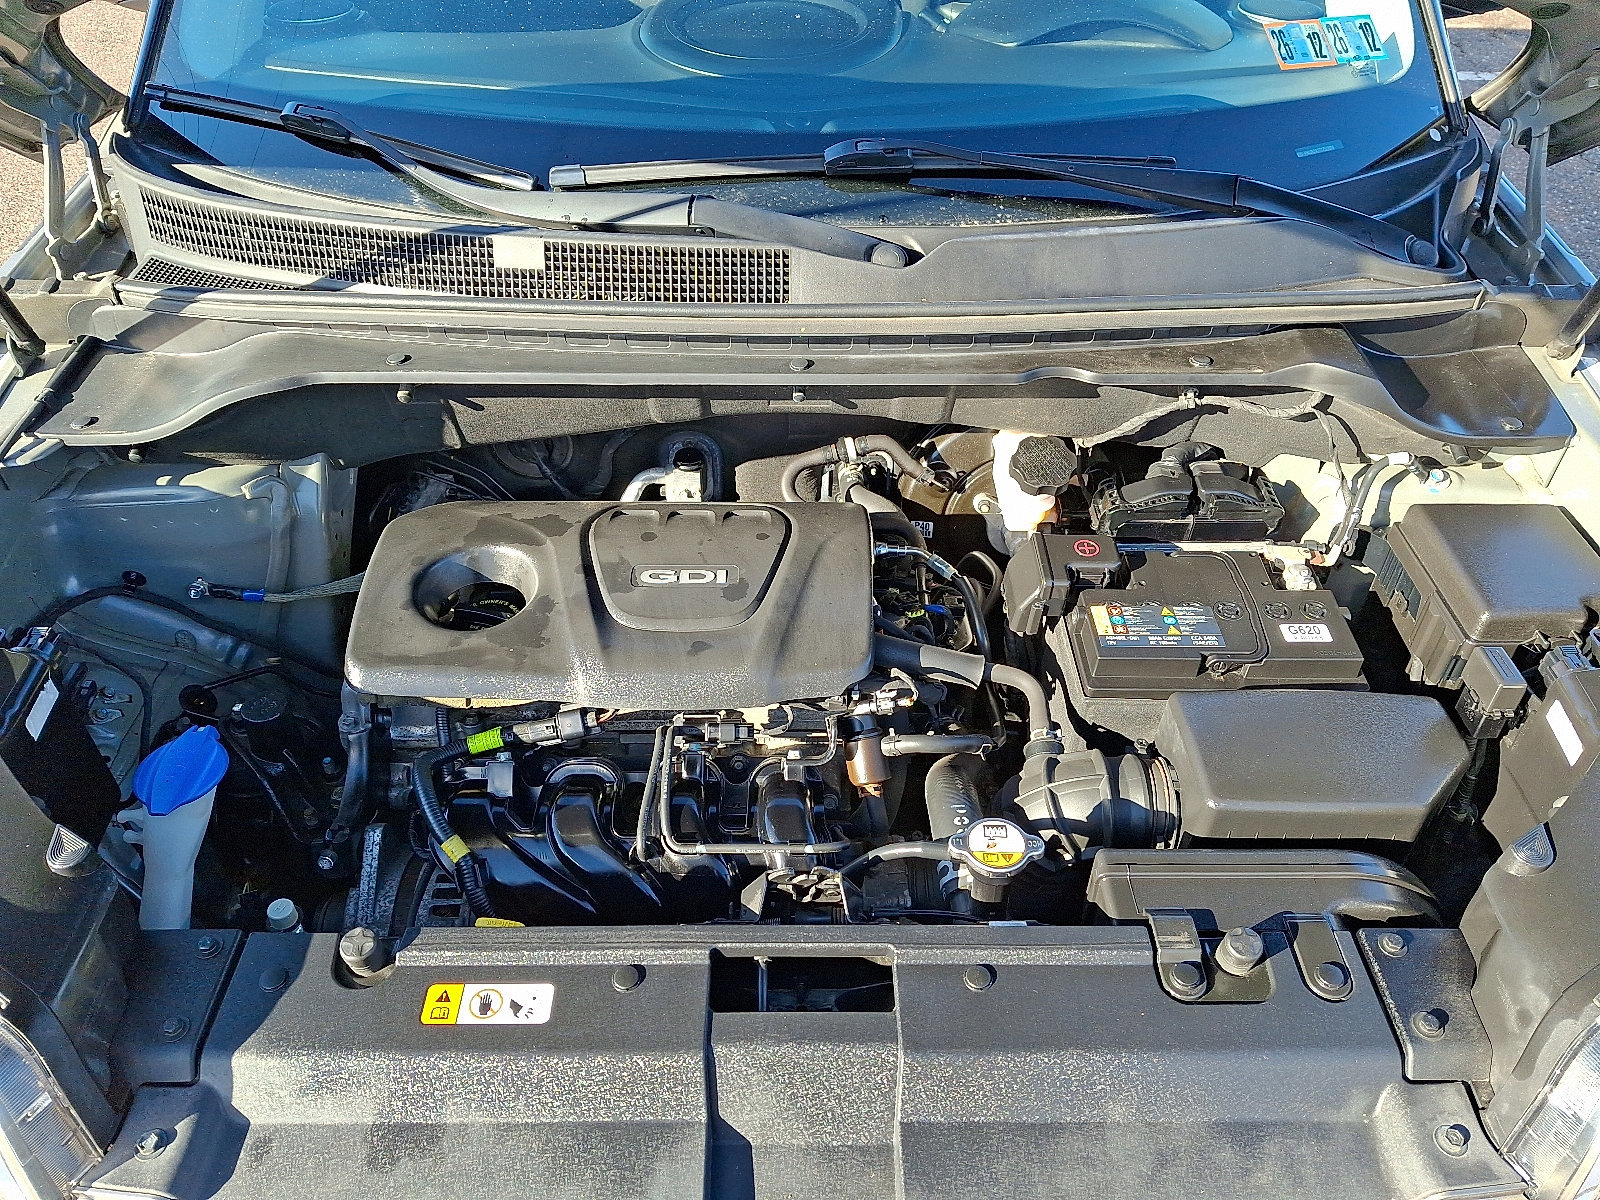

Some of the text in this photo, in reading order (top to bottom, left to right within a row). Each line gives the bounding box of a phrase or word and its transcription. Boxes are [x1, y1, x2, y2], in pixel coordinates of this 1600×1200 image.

[1271, 29, 1295, 61] 26
[1306, 31, 1327, 59] 12
[1326, 23, 1349, 55] 26
[1358, 22, 1381, 52] 12
[640, 569, 729, 584] GDI
[1288, 625, 1321, 635] G620
